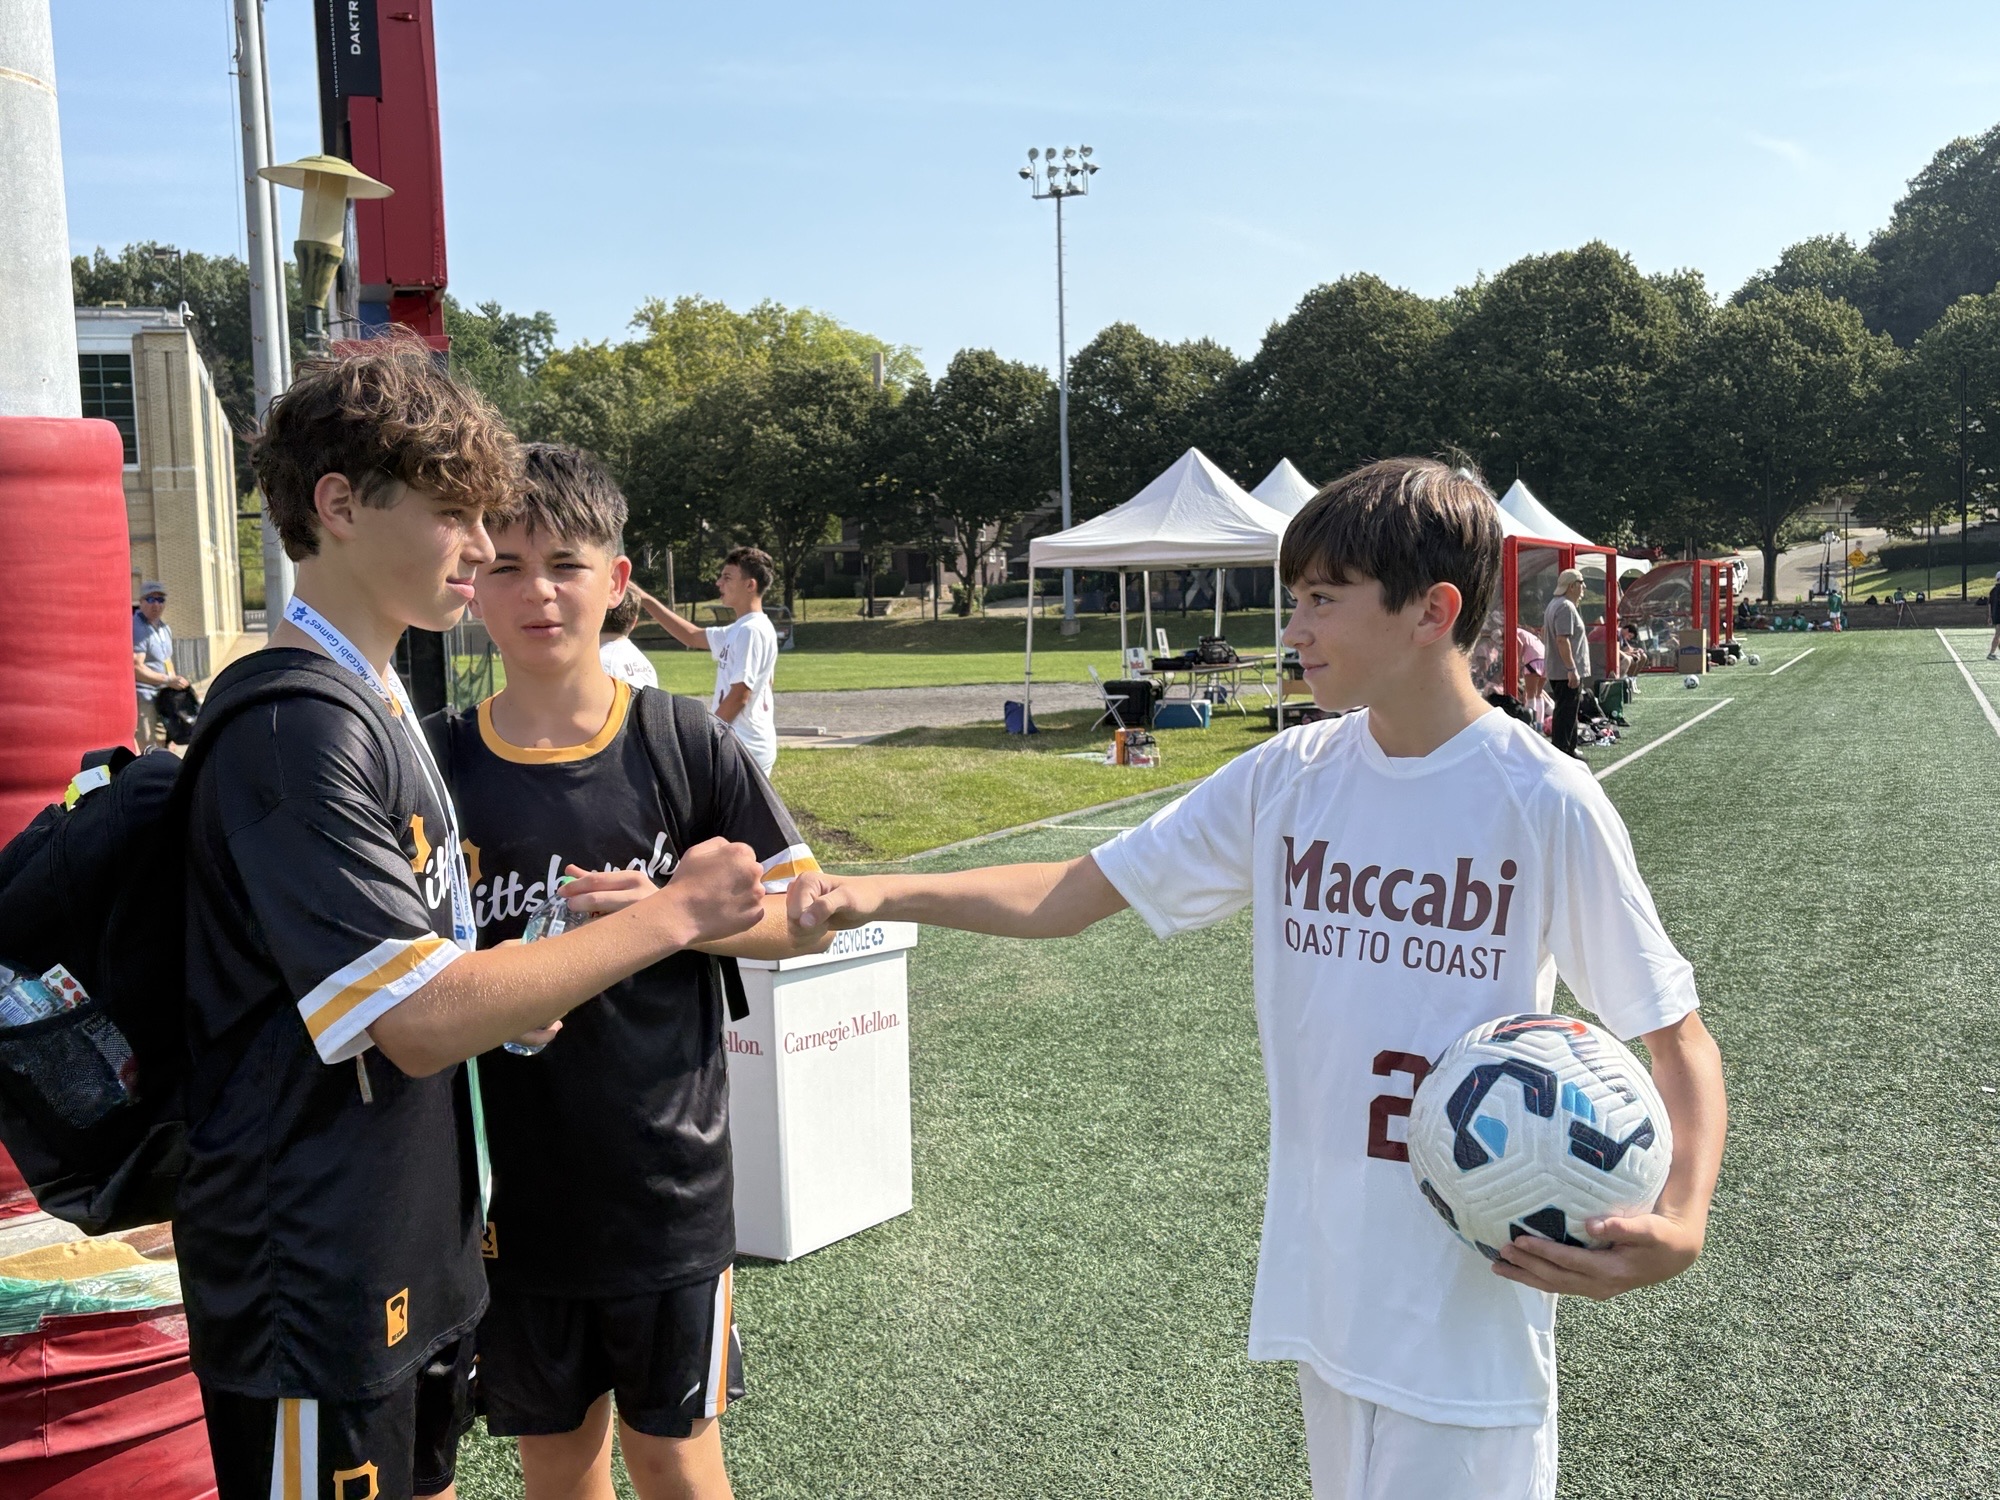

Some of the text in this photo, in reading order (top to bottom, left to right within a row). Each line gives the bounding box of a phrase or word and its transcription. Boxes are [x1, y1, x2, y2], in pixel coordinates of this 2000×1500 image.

[348, 0, 361, 55] DAKTR
[335, 645, 371, 681] Maccabi
[1282, 835, 1518, 936] Maccabi
[833, 928, 871, 955] RECYCLE
[1358, 928, 1390, 964] TO
[1402, 936, 1507, 981] COAST
[784, 1021, 850, 1052] Carnegie
[1367, 1049, 1432, 1163] 2
